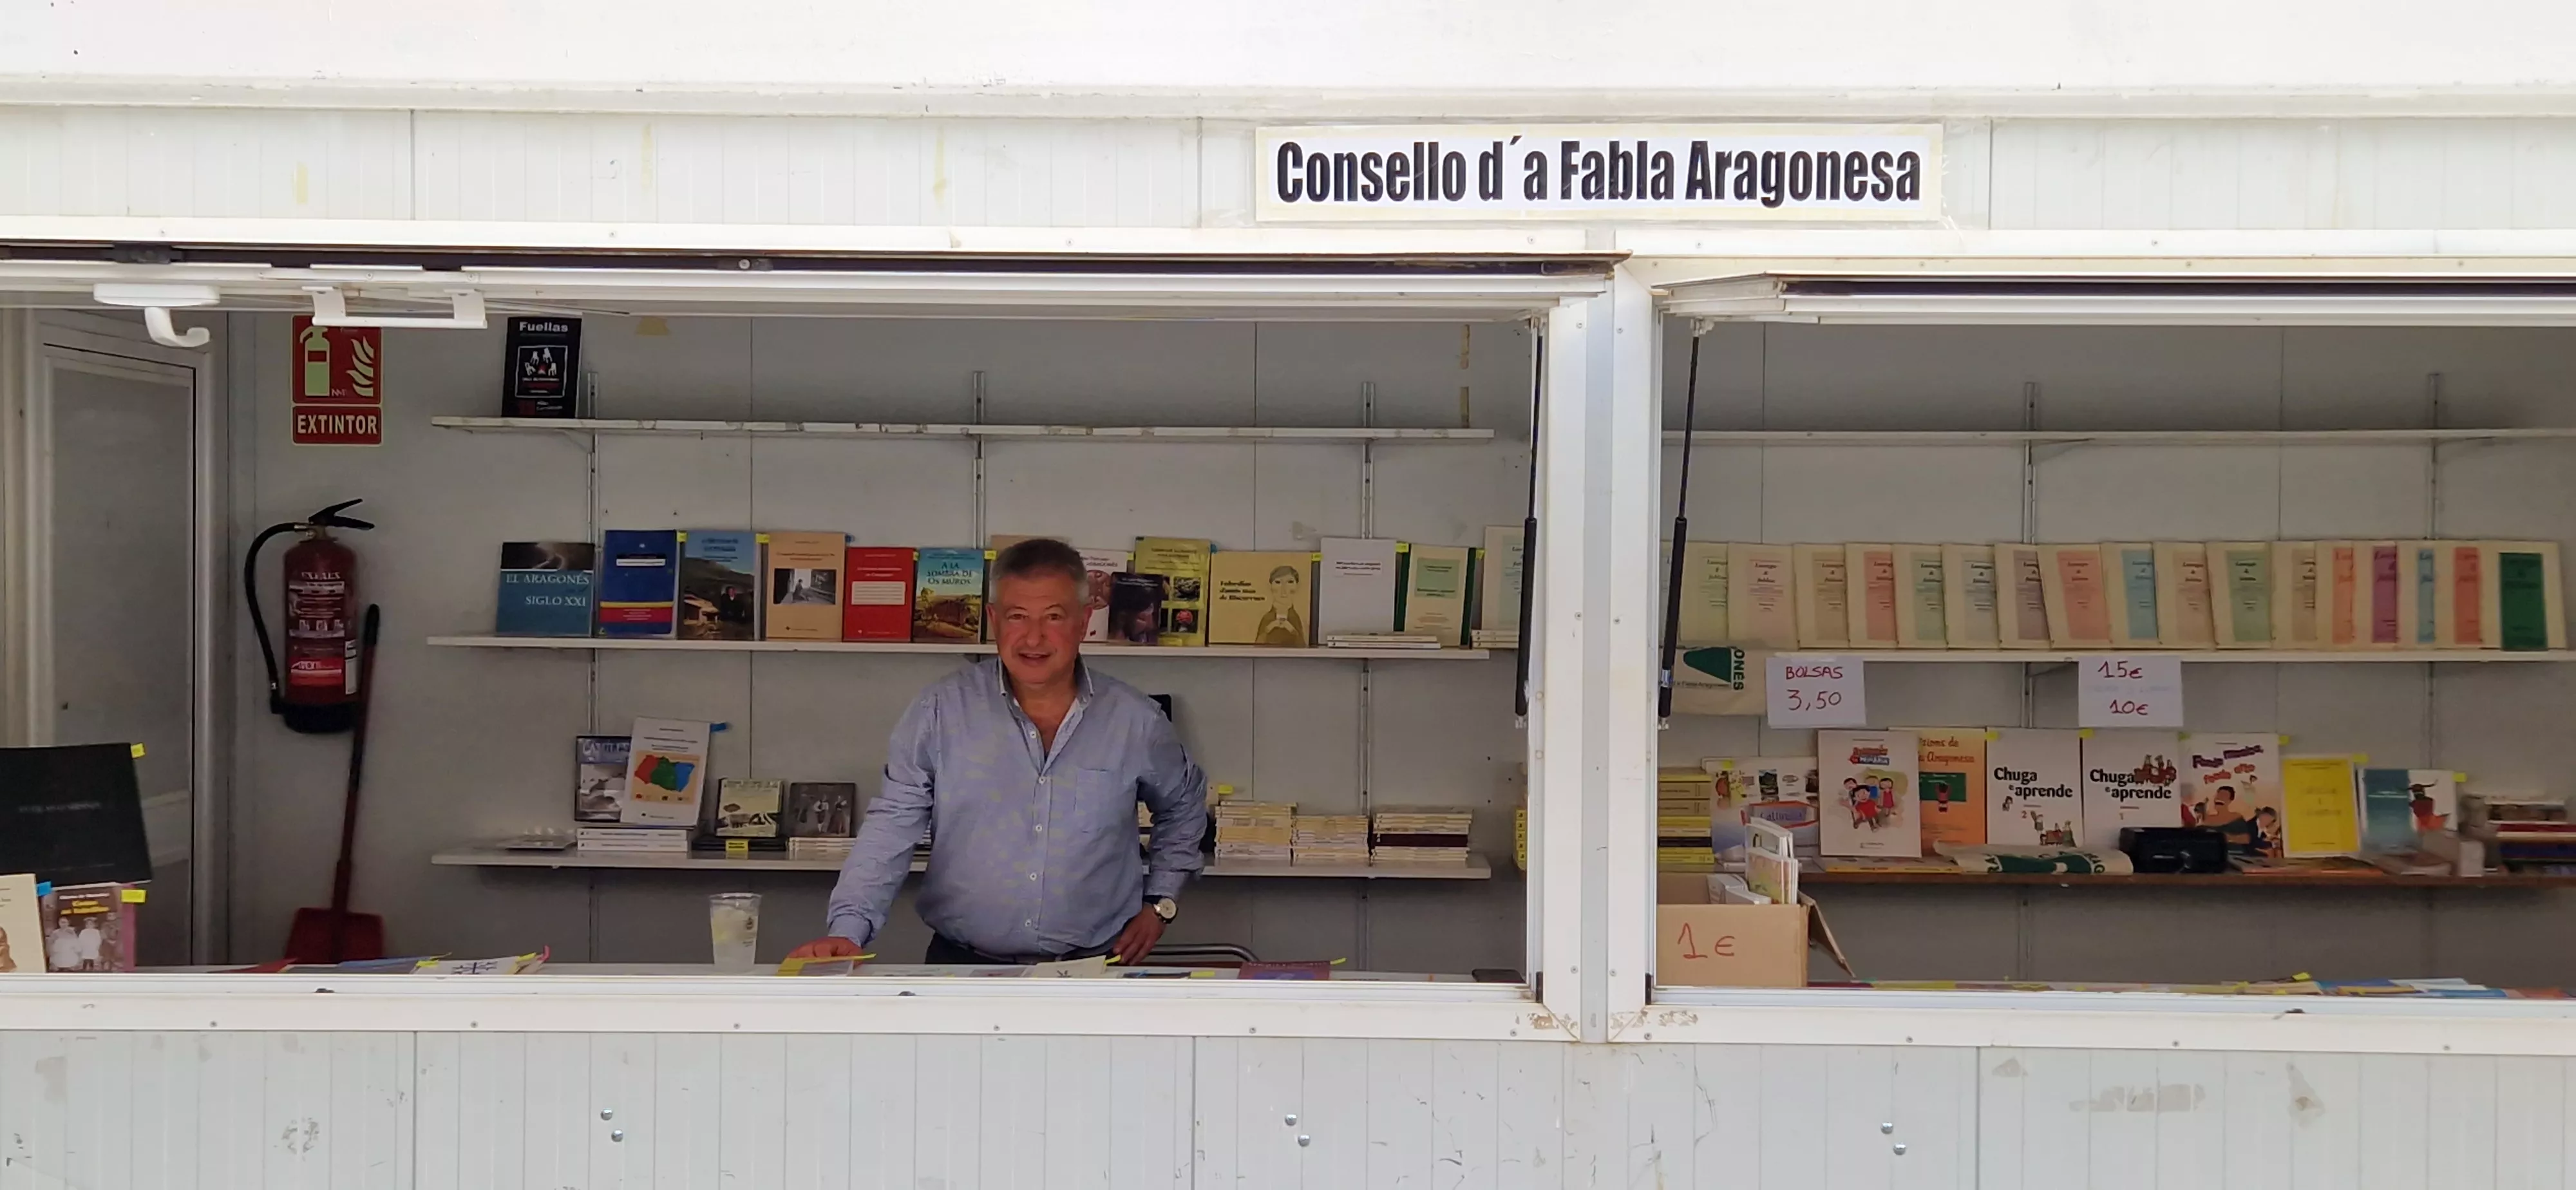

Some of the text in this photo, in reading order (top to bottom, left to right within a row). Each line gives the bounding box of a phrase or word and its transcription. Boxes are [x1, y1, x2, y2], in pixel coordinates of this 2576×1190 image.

[1277, 141, 1466, 202] Consello
[1560, 140, 1674, 200] Fabla
[1685, 140, 1920, 209] Aragonesa
[519, 322, 568, 332] Fuellas
[298, 415, 377, 434] EXTINTOR
[526, 596, 585, 607] SIGLO XXI
[1785, 666, 1843, 679] BOLSAS
[2098, 661, 2143, 679] 15€
[1786, 688, 1842, 711] 3,50
[2109, 699, 2149, 715] 10€
[1994, 768, 2038, 785] Chuga
[2090, 769, 2135, 786] Chuga
[2015, 784, 2073, 800] aprende
[2112, 786, 2172, 802] aprende
